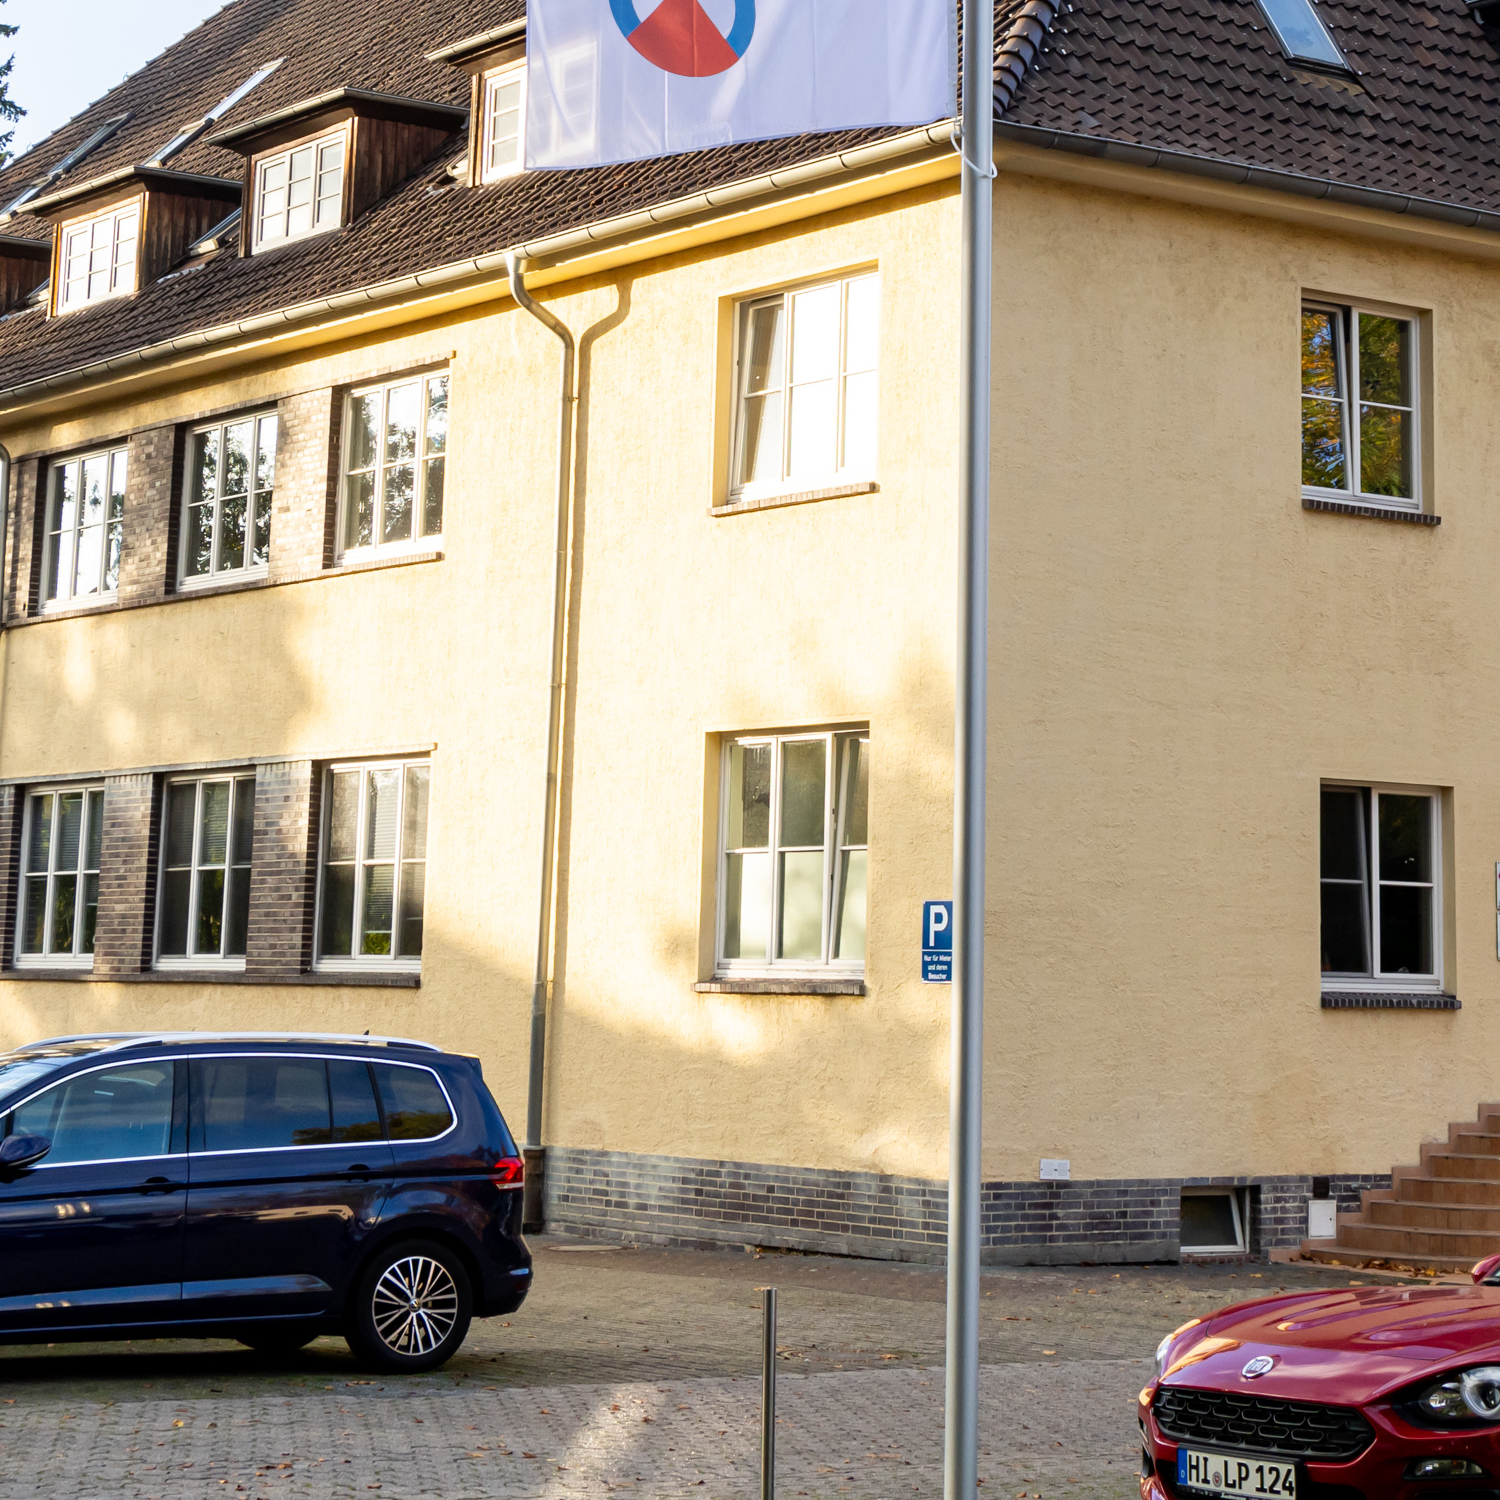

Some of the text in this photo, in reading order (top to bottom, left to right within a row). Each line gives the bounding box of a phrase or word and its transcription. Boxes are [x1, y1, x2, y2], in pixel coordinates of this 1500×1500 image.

[929, 904, 949, 947] P
[928, 972, 947, 980] Besucher
[1188, 1453, 1295, 1497] HI LP 124
